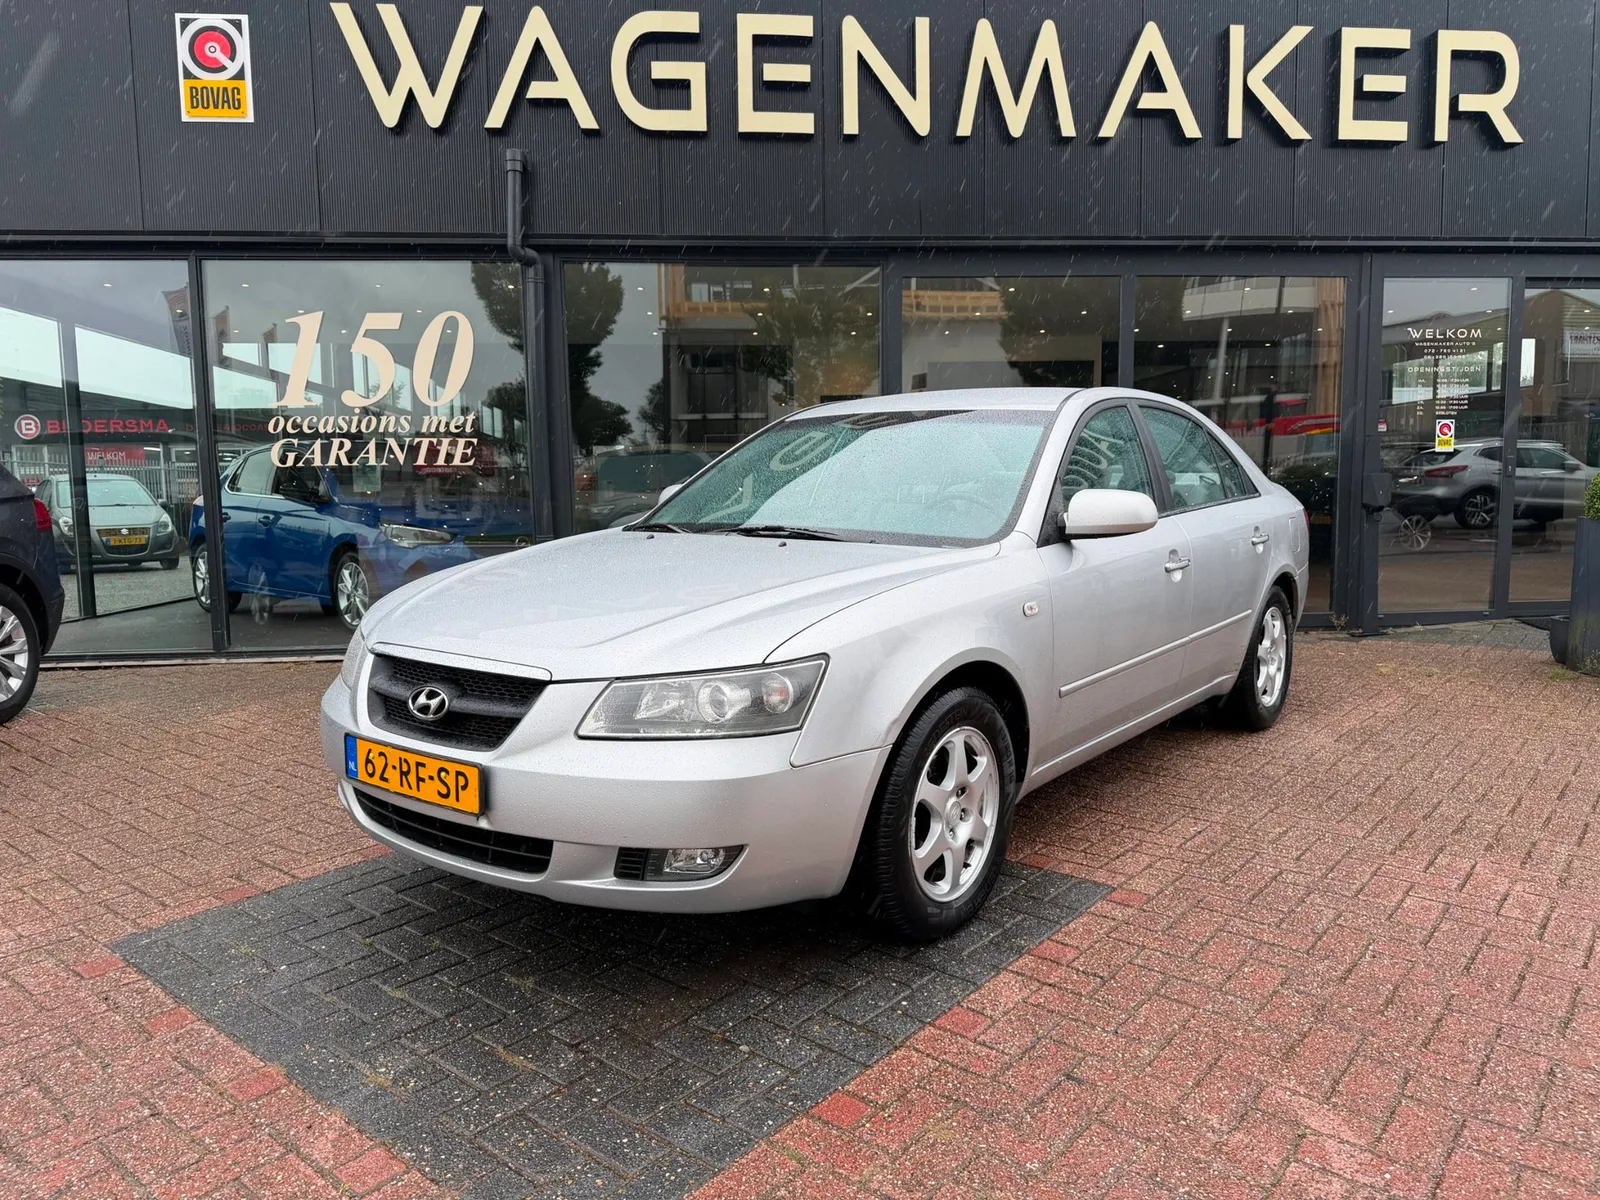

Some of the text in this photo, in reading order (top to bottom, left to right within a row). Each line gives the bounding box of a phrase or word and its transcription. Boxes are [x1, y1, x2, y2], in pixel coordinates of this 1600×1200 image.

[329, 2, 1524, 143] WAGENMAKER
[189, 86, 242, 110] BOVAG
[1408, 328, 1482, 339] WELKOM
[268, 310, 475, 408] 150
[268, 408, 476, 434] occasions met
[271, 437, 478, 467] GARANTIE
[348, 748, 469, 802] NL 62-RF-SP
